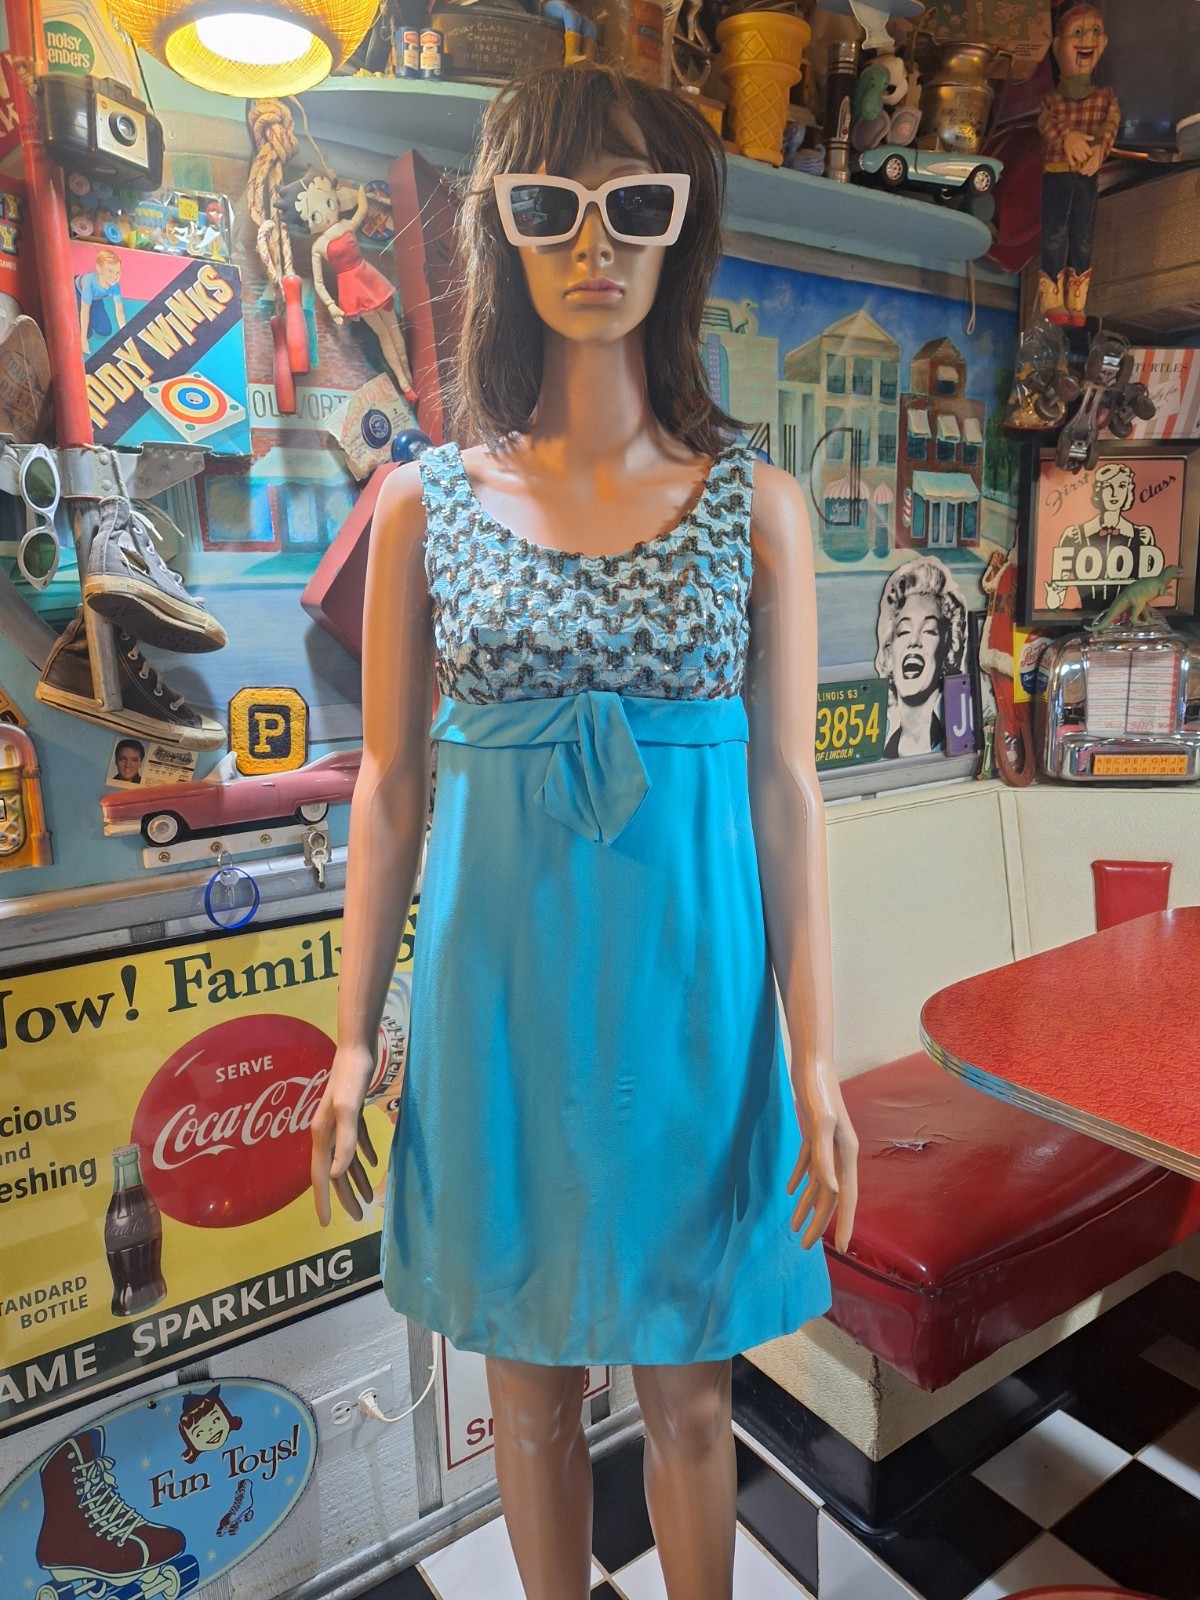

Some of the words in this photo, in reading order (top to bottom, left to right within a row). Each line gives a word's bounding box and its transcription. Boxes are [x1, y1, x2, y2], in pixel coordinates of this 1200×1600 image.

[47, 31, 82, 51] noisy
[86, 336, 155, 429] IDDLY
[137, 264, 234, 360] WINKS
[1134, 362, 1189, 373] TURTLES
[1045, 471, 1091, 516] First
[1139, 474, 1177, 504] Class
[1051, 545, 1165, 581] FOOD
[817, 690, 845, 702] LINOIS
[847, 689, 859, 699] 63
[253, 711, 286, 754] P
[815, 702, 880, 750] 3854
[825, 748, 854, 762] LINCOLN
[164, 930, 343, 1013] Famil
[215, 1055, 274, 1083] SERVE
[0, 1101, 77, 1138] cious
[0, 1142, 31, 1167] nd
[0, 1157, 97, 1204] eshing
[0, 1275, 88, 1317] TANDARD
[21, 1293, 89, 1329] BOTTLE
[0, 1343, 98, 1405] AME
[131, 1249, 354, 1358] SPARKLING
[148, 1468, 212, 1509] Fun
[221, 1424, 300, 1482] Toys!
